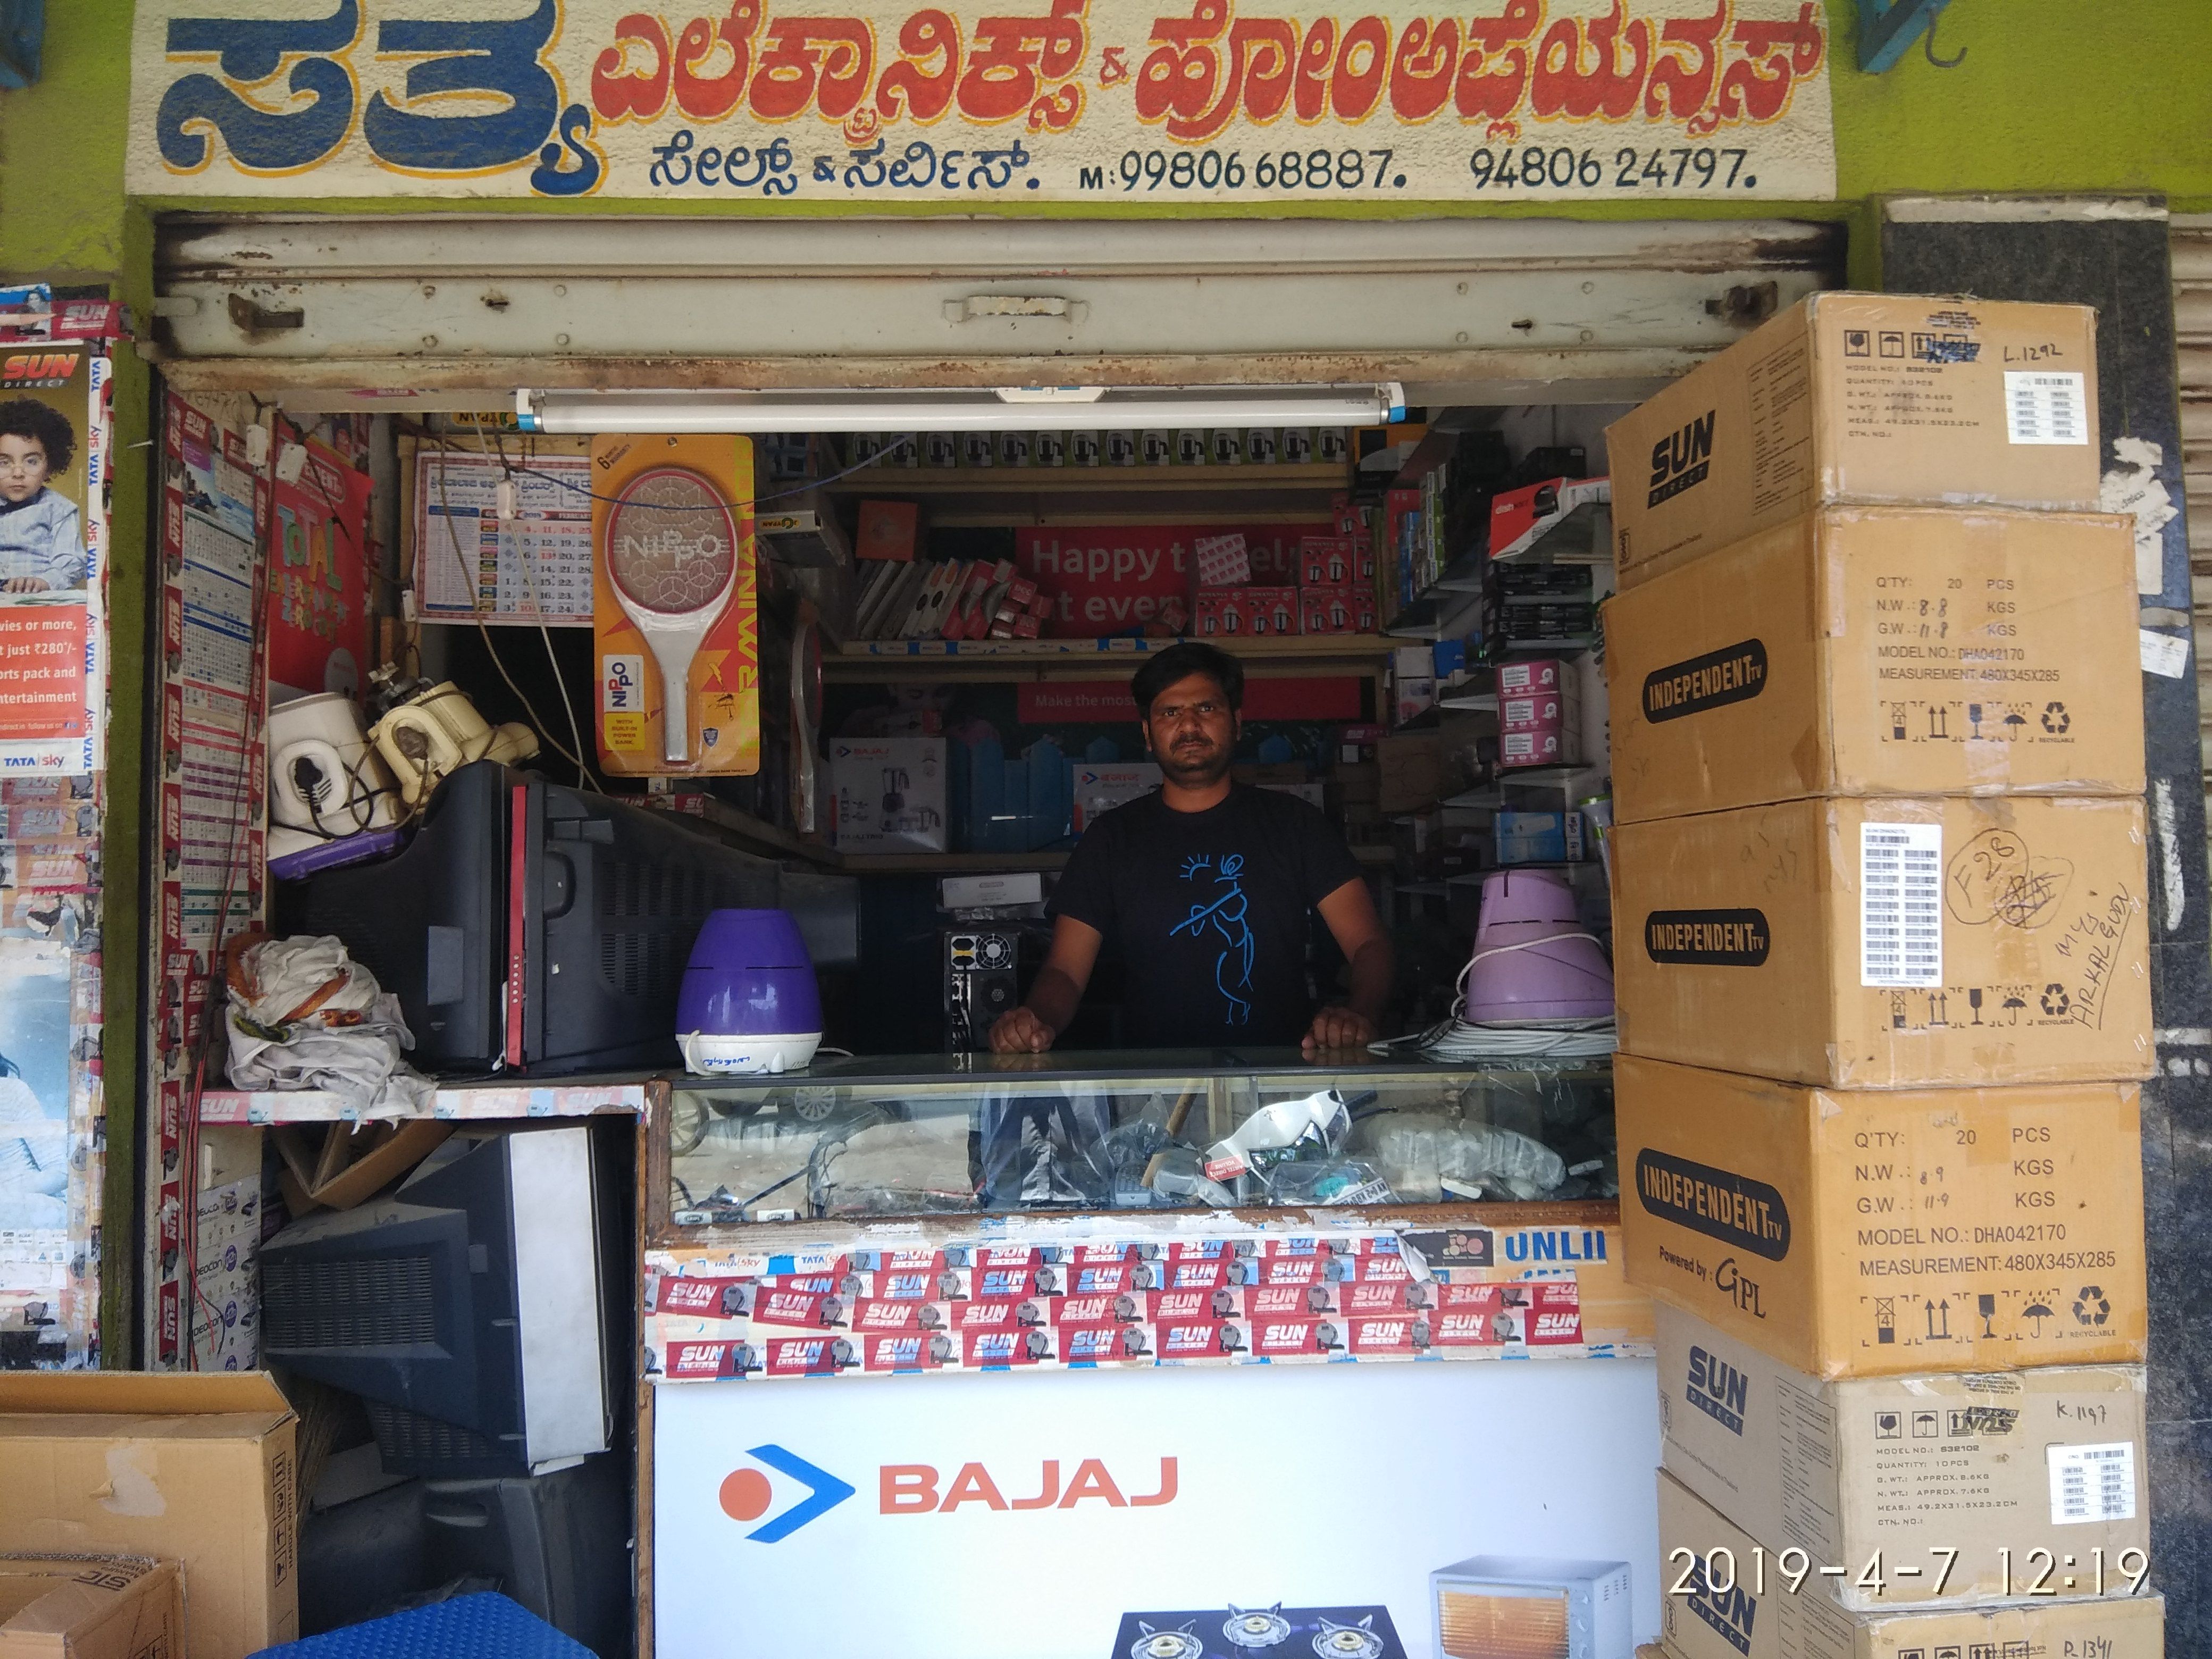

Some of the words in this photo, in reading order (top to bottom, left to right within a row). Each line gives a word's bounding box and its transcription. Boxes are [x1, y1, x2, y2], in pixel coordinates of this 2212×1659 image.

[1100, 47, 1127, 85] &
[812, 155, 835, 181] &
[4, 353, 80, 380] SUN
[4, 379, 65, 388] DIRECT
[91, 360, 102, 392] TATA
[1650, 410, 1717, 487] SUN
[88, 454, 99, 486] TATA
[597, 456, 611, 470] 6
[624, 530, 722, 569] NIPPO
[87, 547, 97, 580] TATA
[1032, 540, 1161, 582] Happy
[1947, 578, 1963, 589] 20
[1987, 580, 2015, 591] PCS
[1987, 601, 2016, 614] KGS
[26, 621, 39, 631] or
[42, 621, 77, 631] more,
[1988, 624, 2017, 636] KGS
[6, 644, 30, 658] just
[85, 641, 95, 675] TATA
[1878, 647, 1924, 658] MODEL
[23, 667, 51, 682] pack
[54, 666, 76, 678] and
[1649, 653, 1753, 711] INDEPENDENT
[608, 661, 633, 708] NIPPO
[1035, 694, 1072, 707] Make
[1075, 694, 1098, 706] the
[83, 737, 93, 769] TATA
[4, 757, 36, 766] TATA
[41, 756, 64, 769] sky
[1652, 923, 1755, 952] INDEPENDENT
[1956, 1129, 1977, 1145] 20
[2012, 1127, 2051, 1143] PCS
[2013, 1159, 2055, 1176] KGS
[1643, 1164, 1770, 1239] INDEPENDENT
[2015, 1191, 2056, 1208] KGS
[1857, 1228, 1926, 1246] MODEL
[1974, 1224, 2067, 1244] DHA042170
[1659, 1245, 1695, 1272] Powered
[1079, 1267, 1124, 1284] SUN
[1175, 1263, 1220, 1280] SUN
[1271, 1261, 1315, 1277] SUN
[886, 1273, 931, 1291] SUN
[984, 1270, 1028, 1286] SUN
[670, 1282, 717, 1300] SUN
[769, 1293, 814, 1311] SUN
[866, 1303, 912, 1321] SUN
[1361, 1321, 1405, 1338] SUN
[1441, 1314, 1485, 1330] SUN
[1536, 1313, 1580, 1329] SUN
[1168, 1326, 1213, 1343] SUN
[1264, 1324, 1309, 1341] SUN
[2069, 1329, 2117, 1338] RECYCLABLE
[680, 1345, 725, 1361] SUN
[779, 1340, 825, 1358] SUN
[876, 1337, 922, 1354] SUN
[1687, 1345, 1748, 1415] SUN
[1689, 1390, 1741, 1433] DIRECT
[1876, 1461, 1928, 1470] QUANTITY:
[879, 1456, 1178, 1515] BAJAJ
